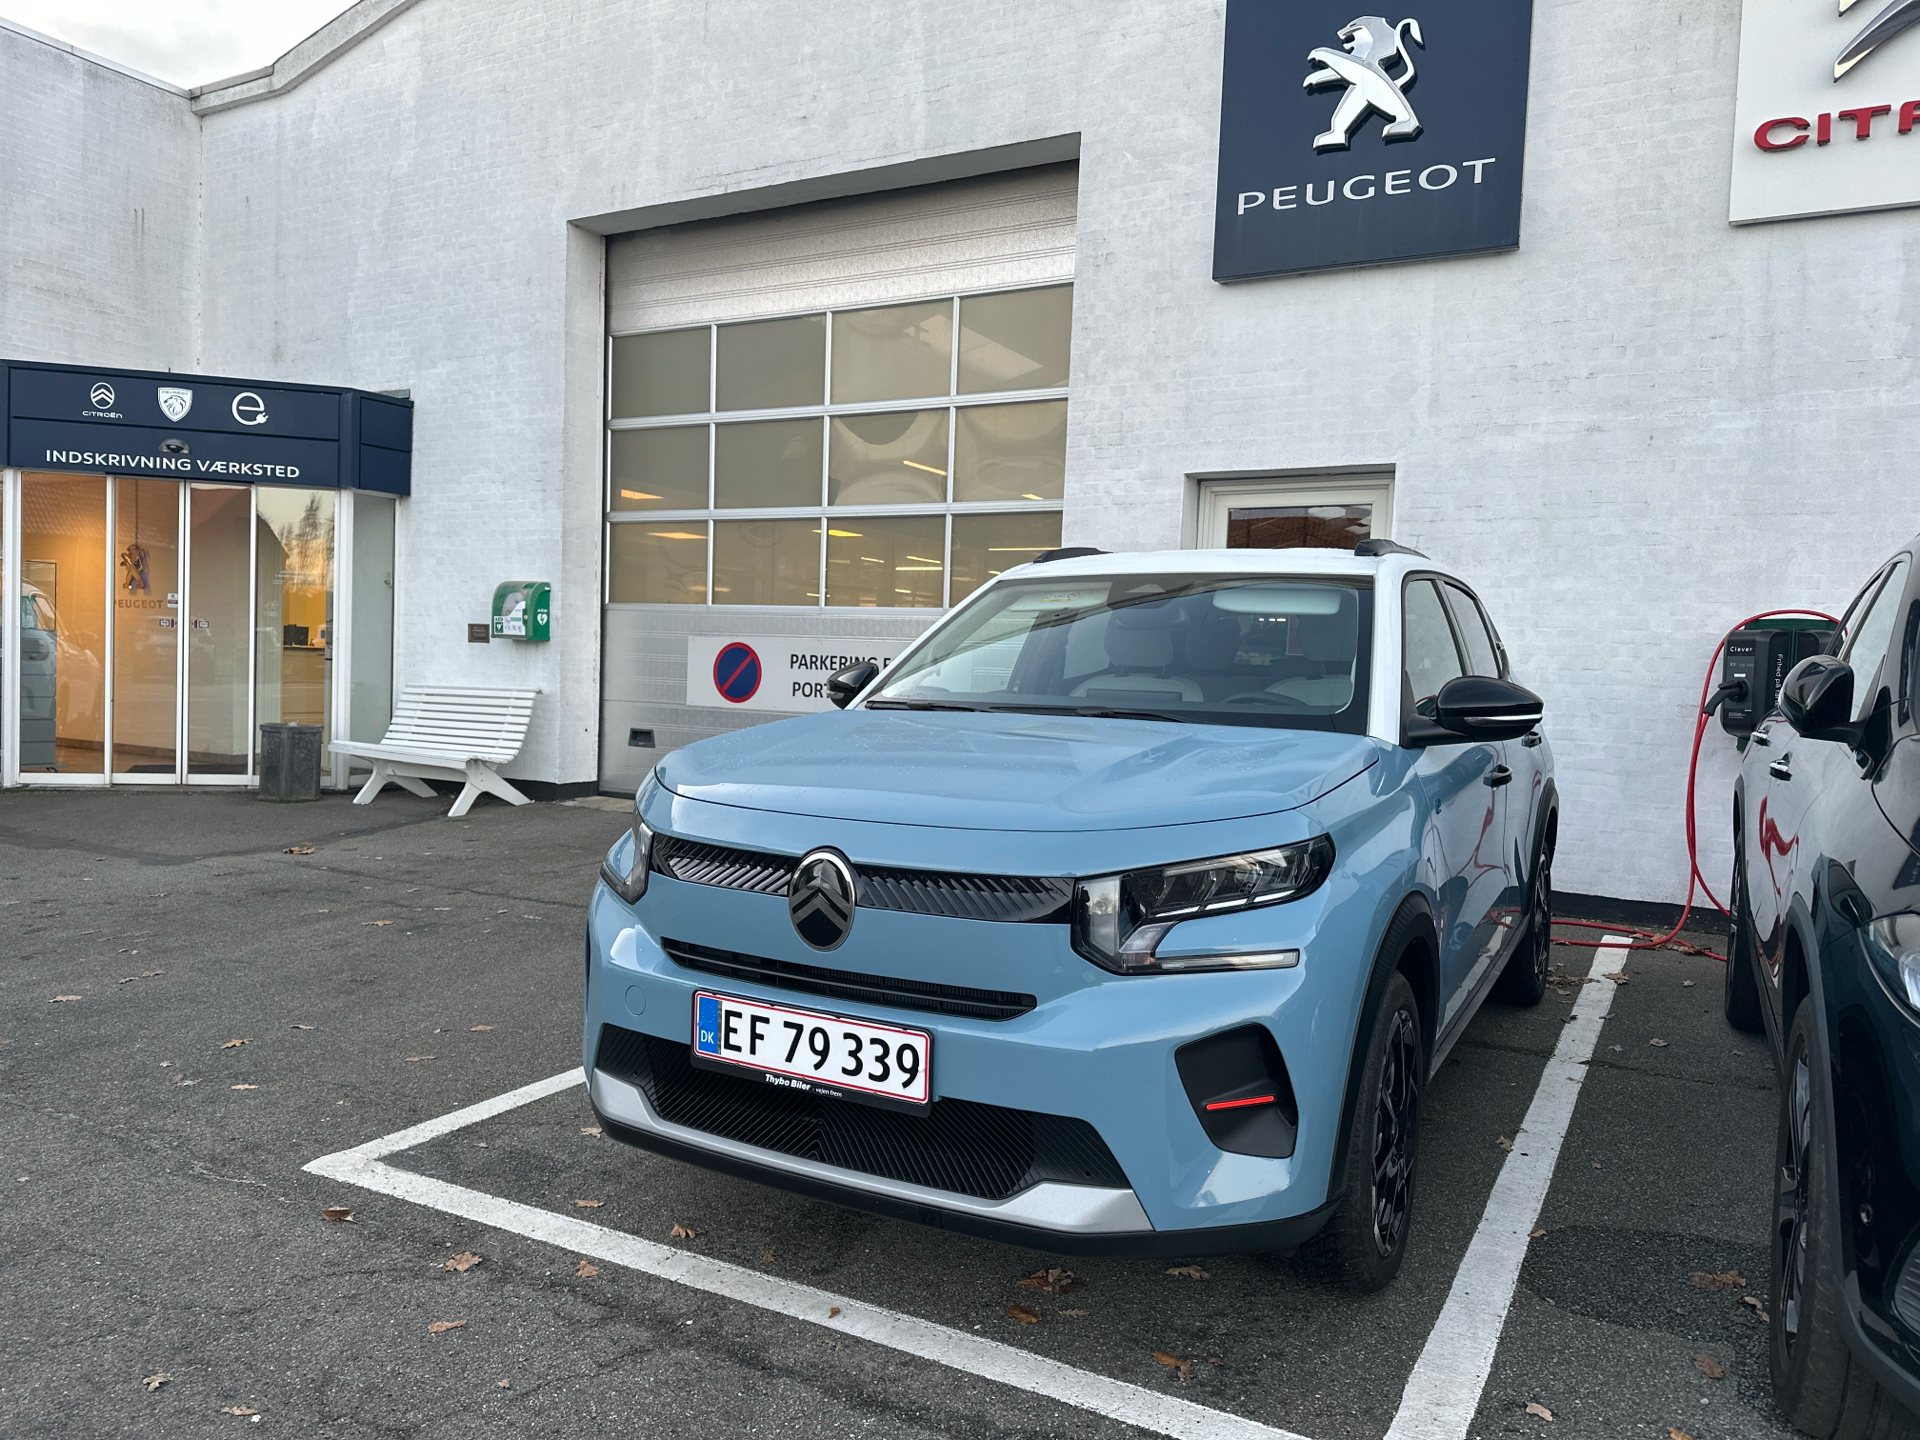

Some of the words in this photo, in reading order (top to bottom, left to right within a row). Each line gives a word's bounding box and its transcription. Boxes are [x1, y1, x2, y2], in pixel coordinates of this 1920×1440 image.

[1237, 157, 1496, 216] PEUGEOT
[45, 449, 192, 471] INDSKRIVNING
[196, 459, 301, 478] VÆRKSTED
[115, 599, 164, 609] EUGEOT
[701, 1030, 714, 1044] DK
[723, 1009, 770, 1055] EF
[783, 1020, 831, 1071] 79
[841, 1032, 920, 1089] 339
[765, 1073, 790, 1086] Thybo
[790, 1079, 811, 1091] Biler
